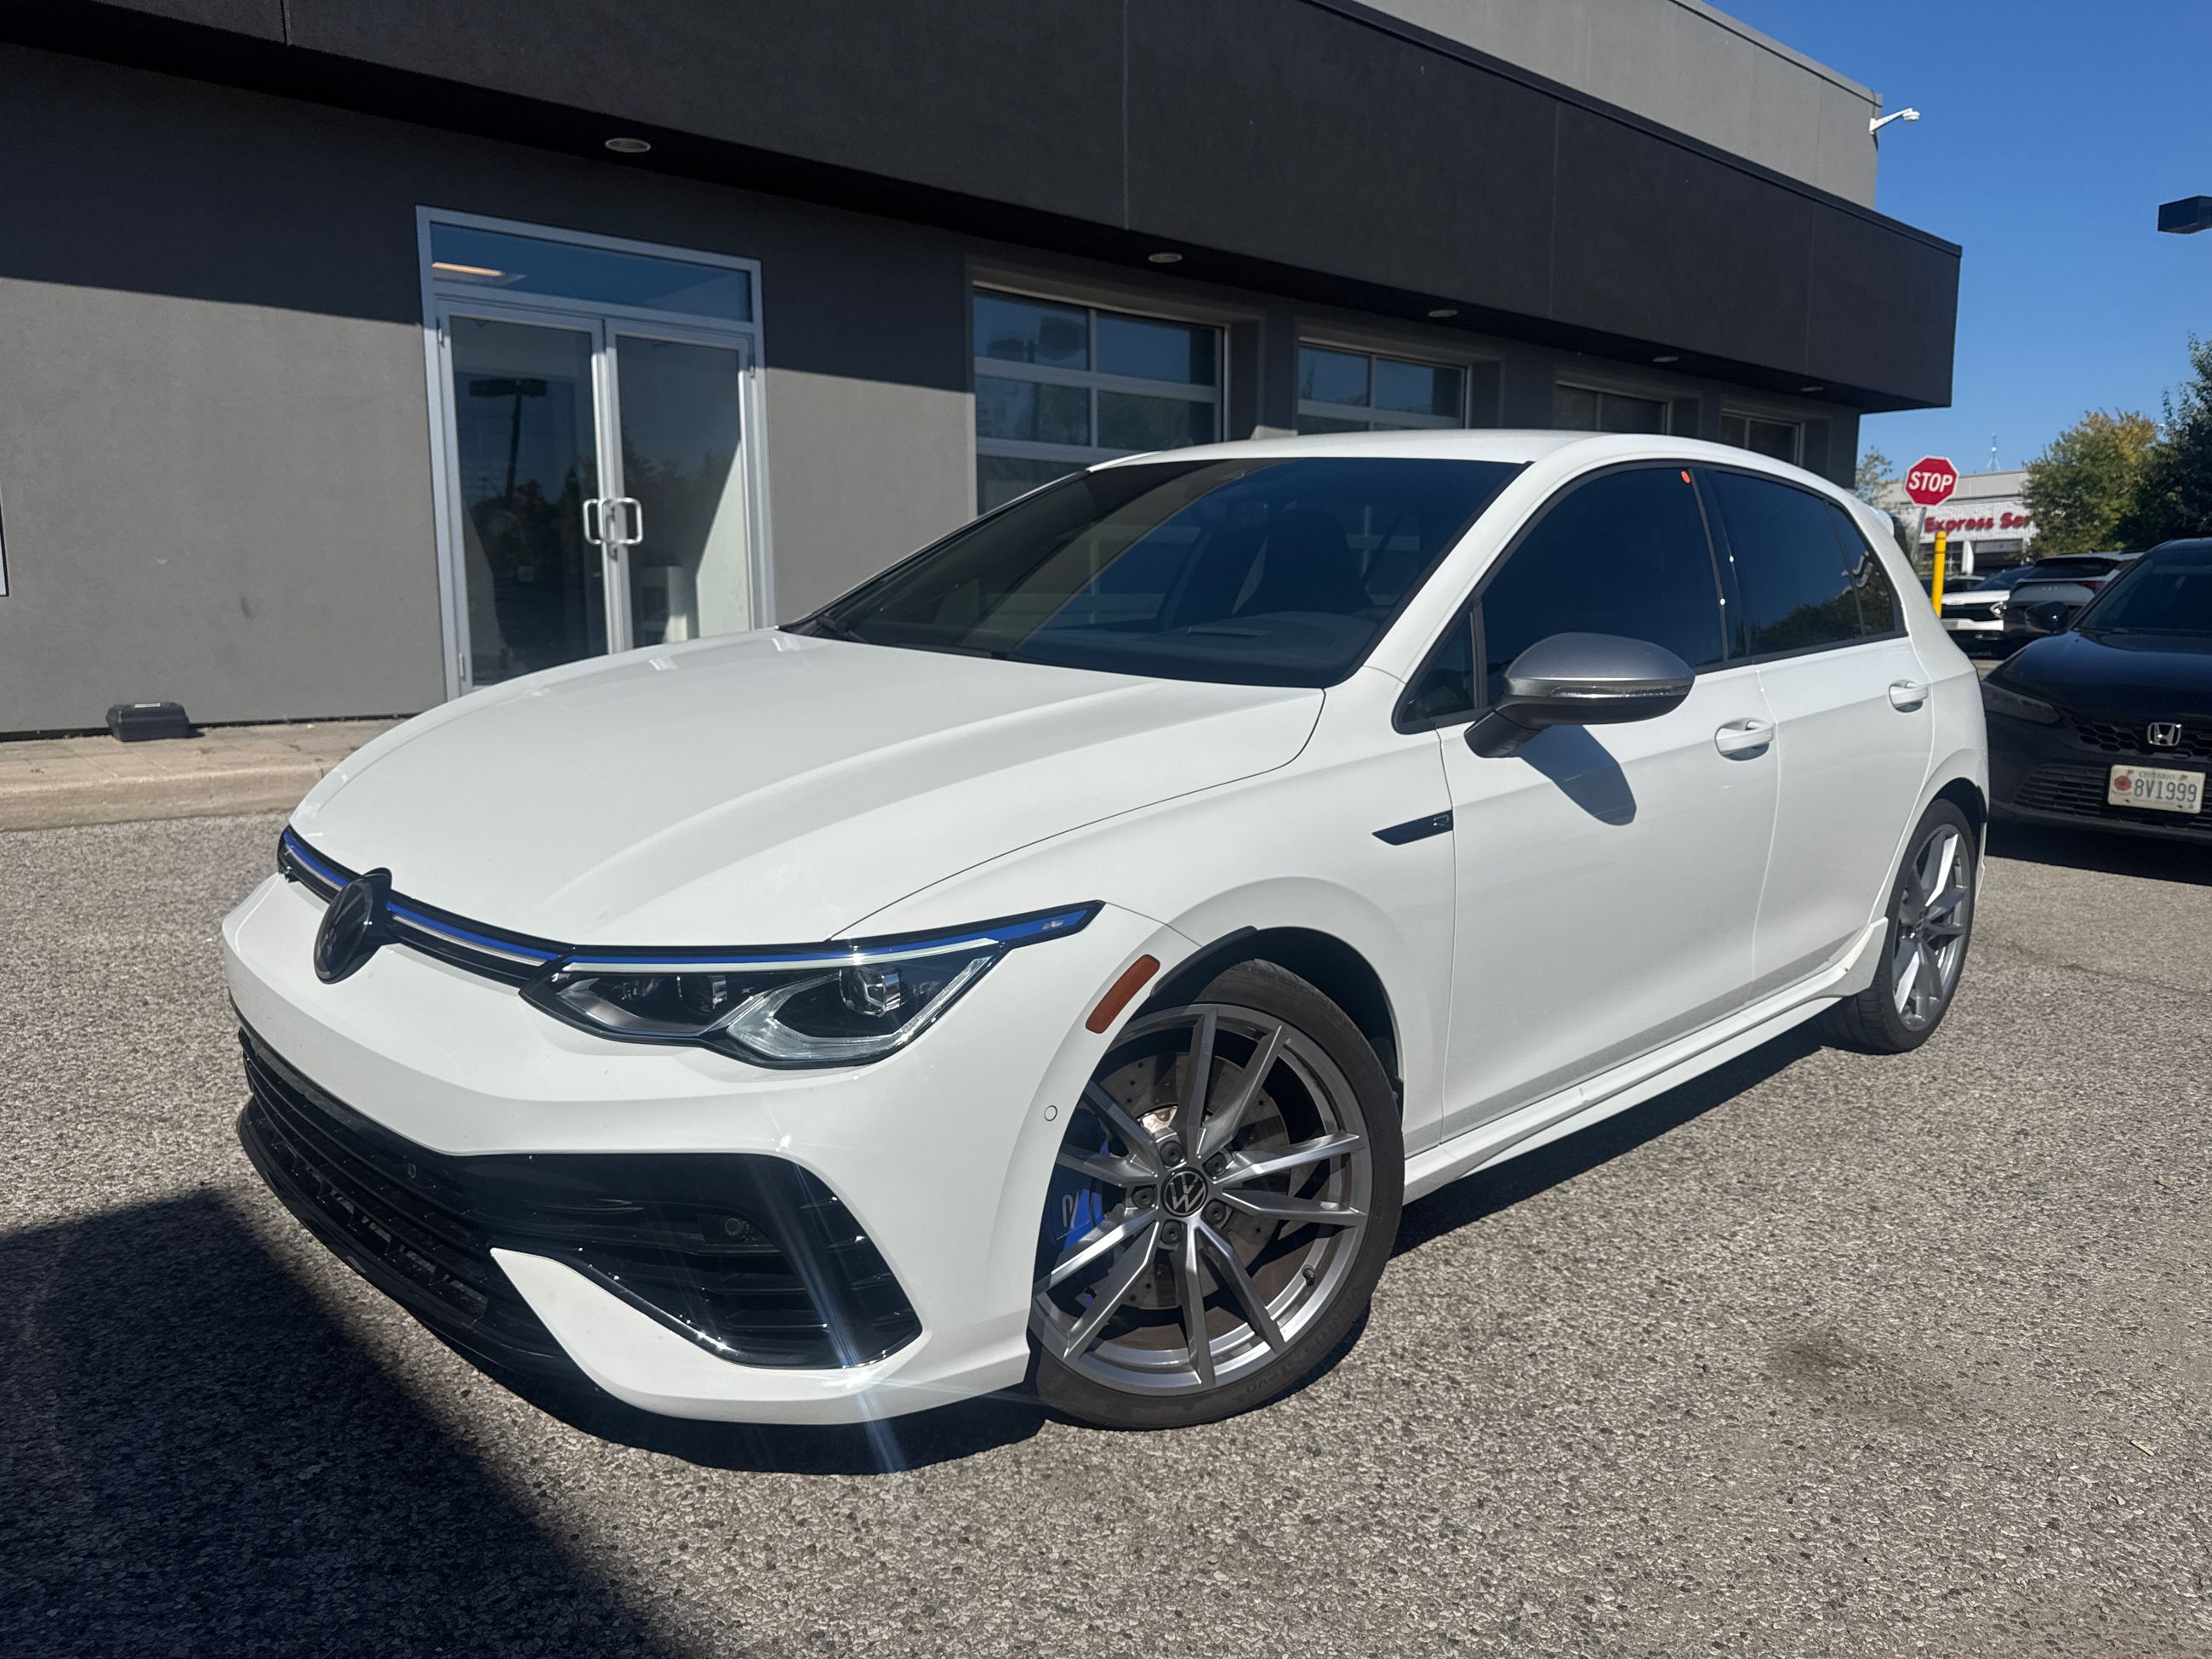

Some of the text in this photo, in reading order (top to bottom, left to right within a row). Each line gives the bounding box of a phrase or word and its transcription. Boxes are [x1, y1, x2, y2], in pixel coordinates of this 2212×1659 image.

[1908, 471, 1953, 493] STOP
[1924, 516, 1995, 535] Express
[2134, 778, 2198, 802] 8V1999
